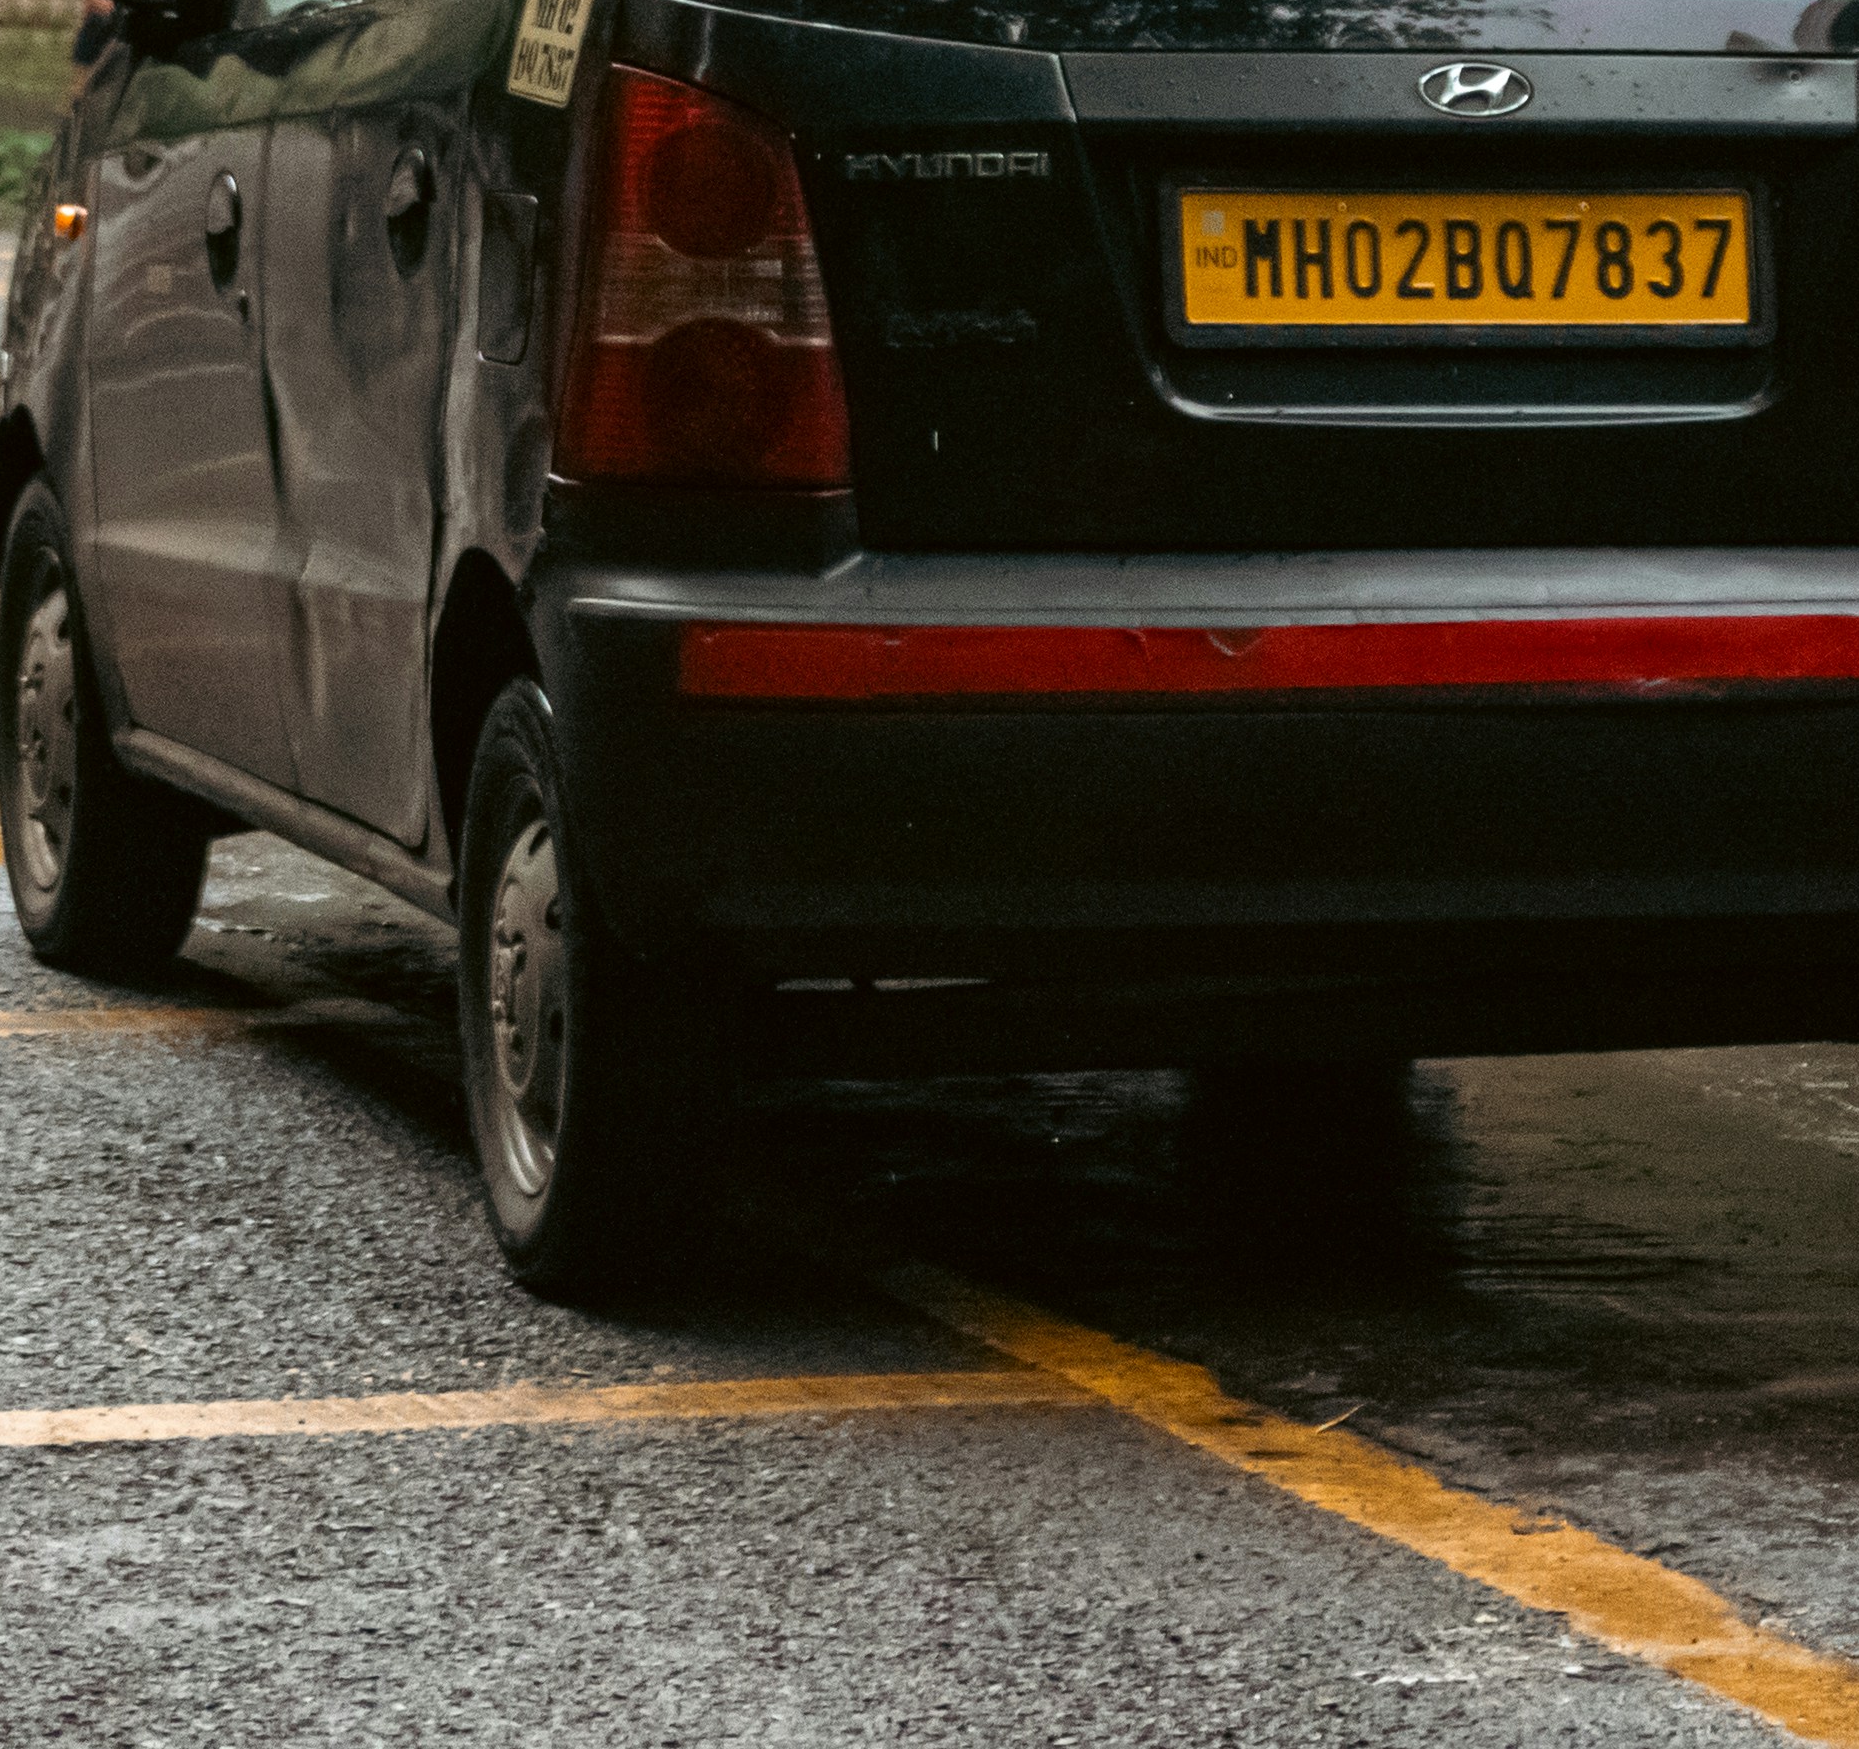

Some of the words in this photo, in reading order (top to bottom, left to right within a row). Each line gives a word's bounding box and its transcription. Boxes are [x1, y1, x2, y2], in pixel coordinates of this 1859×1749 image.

[845, 152, 1050, 179] HYUNDAI
[1195, 246, 1239, 269] IND
[1244, 217, 1734, 300] MH02BQ7837
